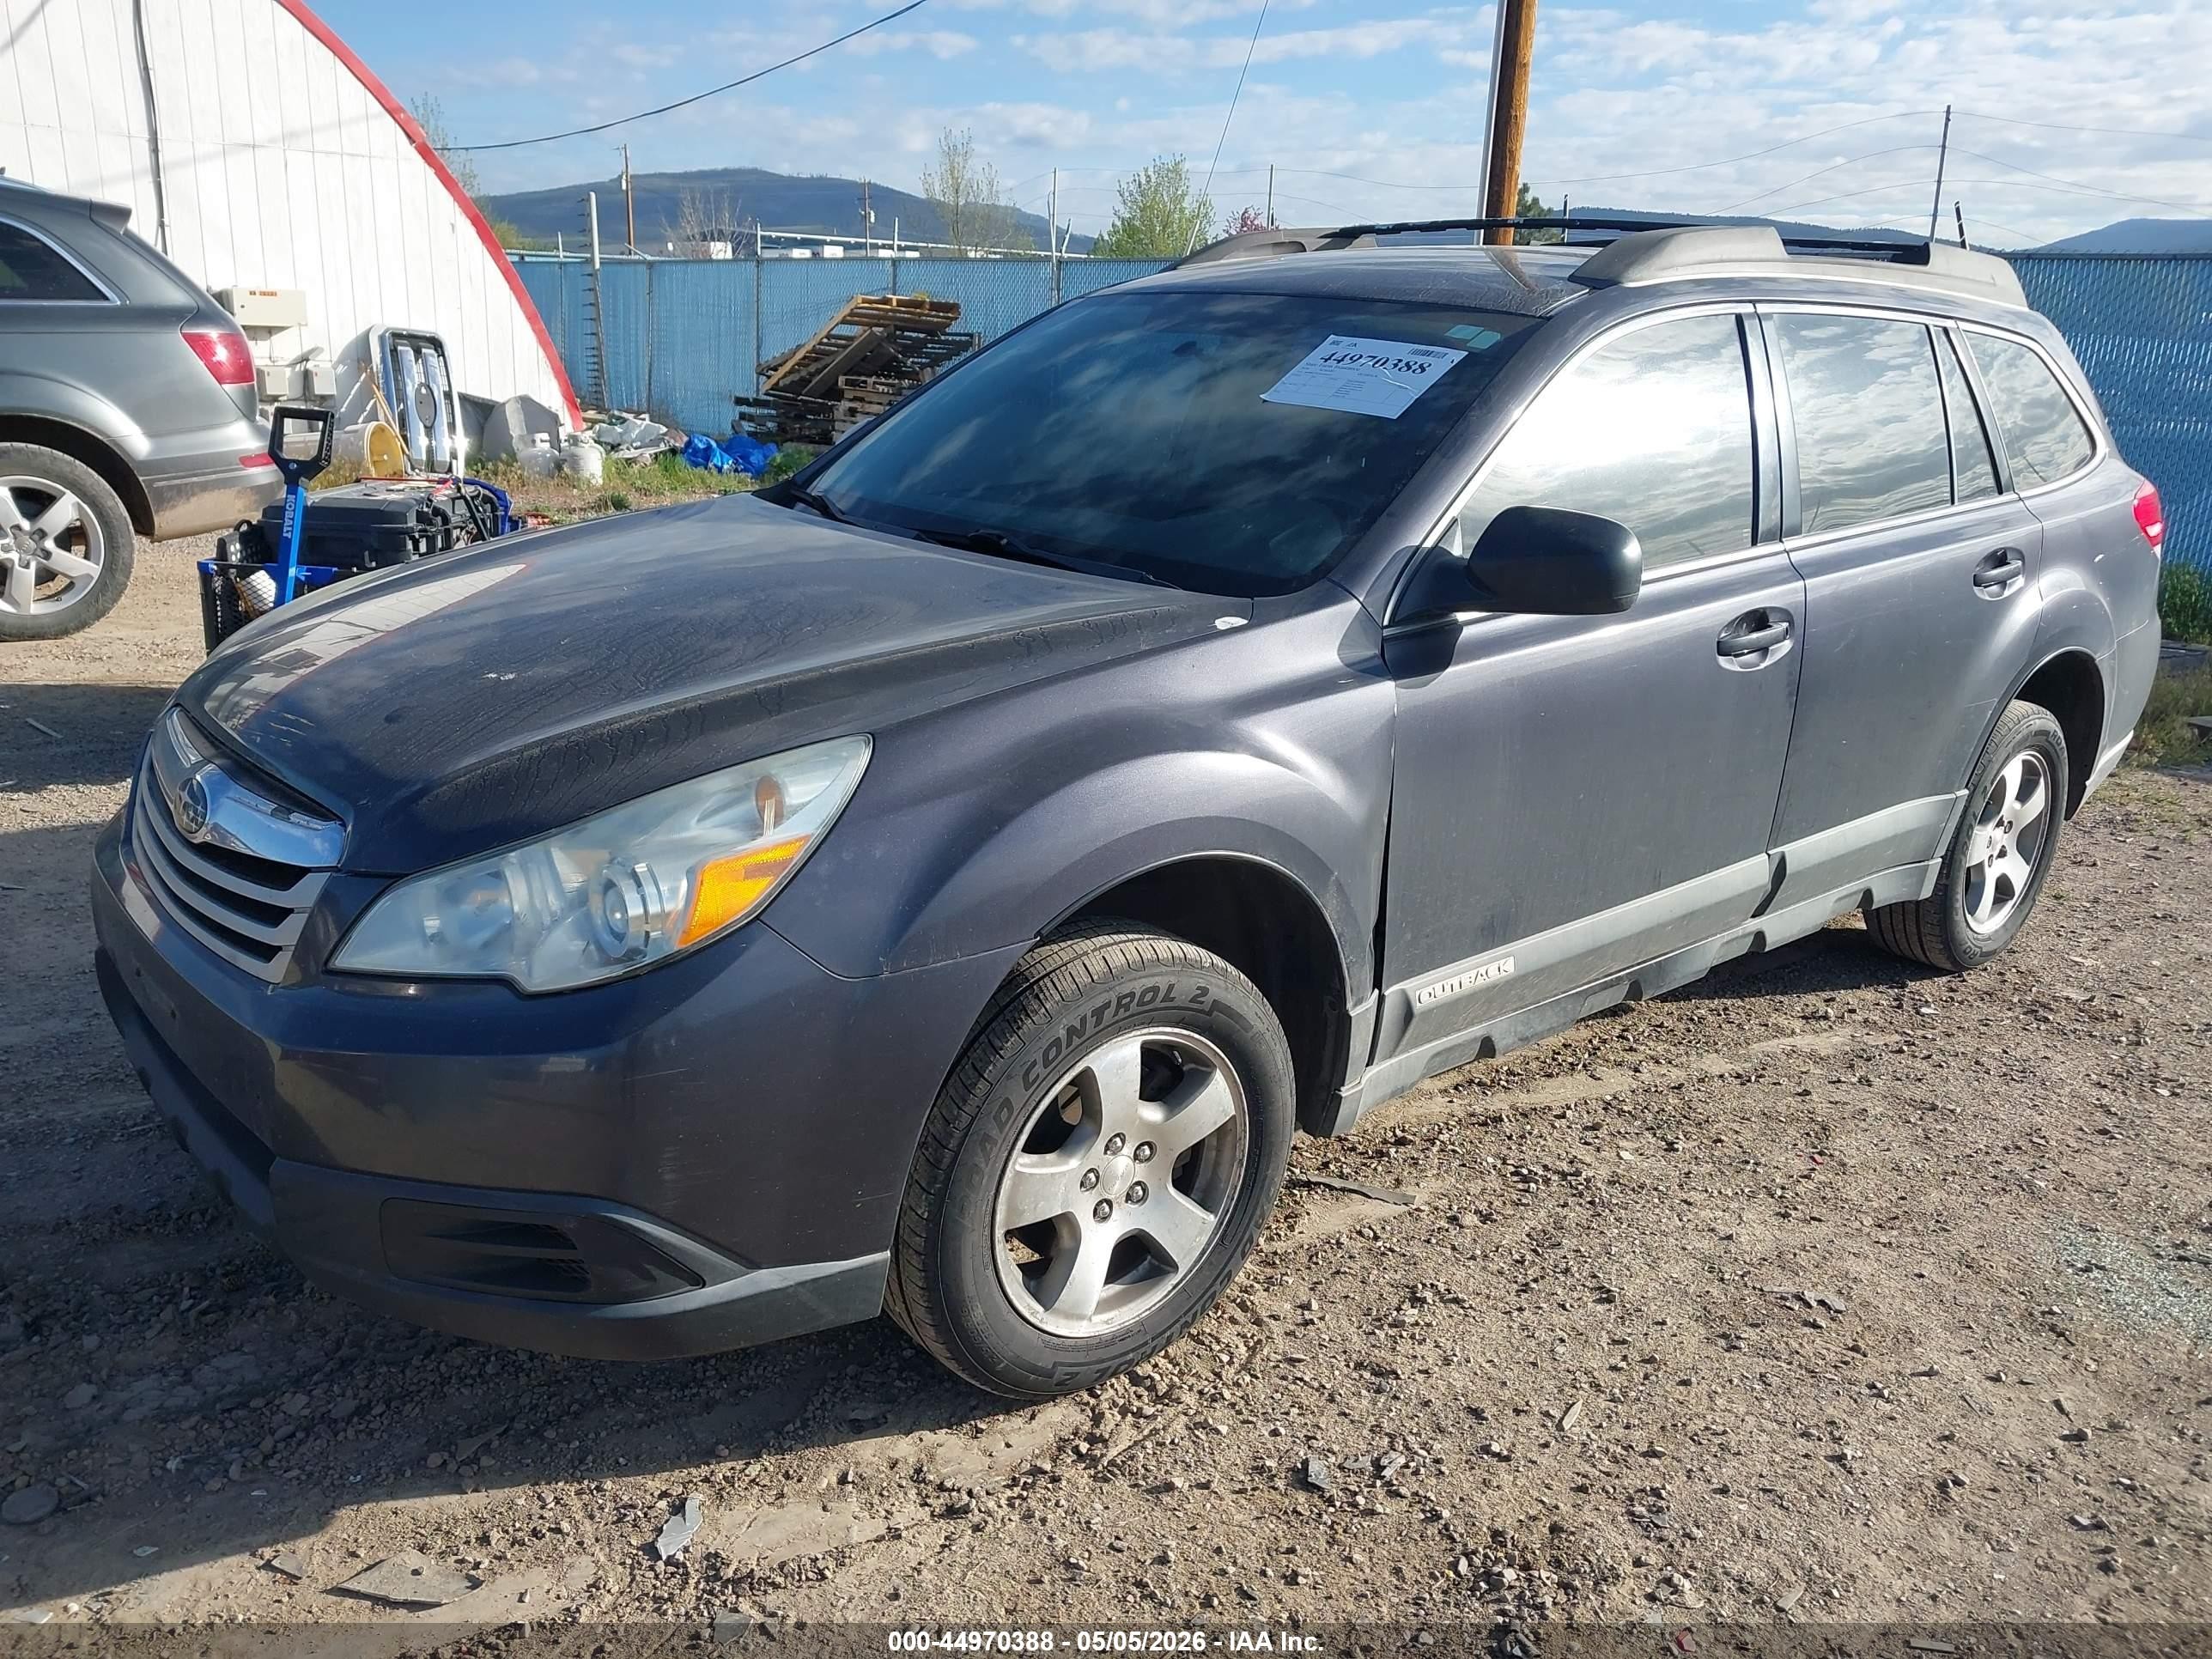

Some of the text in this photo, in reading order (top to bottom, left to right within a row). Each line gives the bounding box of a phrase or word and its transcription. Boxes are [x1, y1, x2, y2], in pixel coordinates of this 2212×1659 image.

[1319, 350, 1433, 375] 44970388
[283, 494, 296, 539] KOBALT
[1022, 983, 1177, 1093] CONTROL
[1188, 985, 1210, 1006] 2
